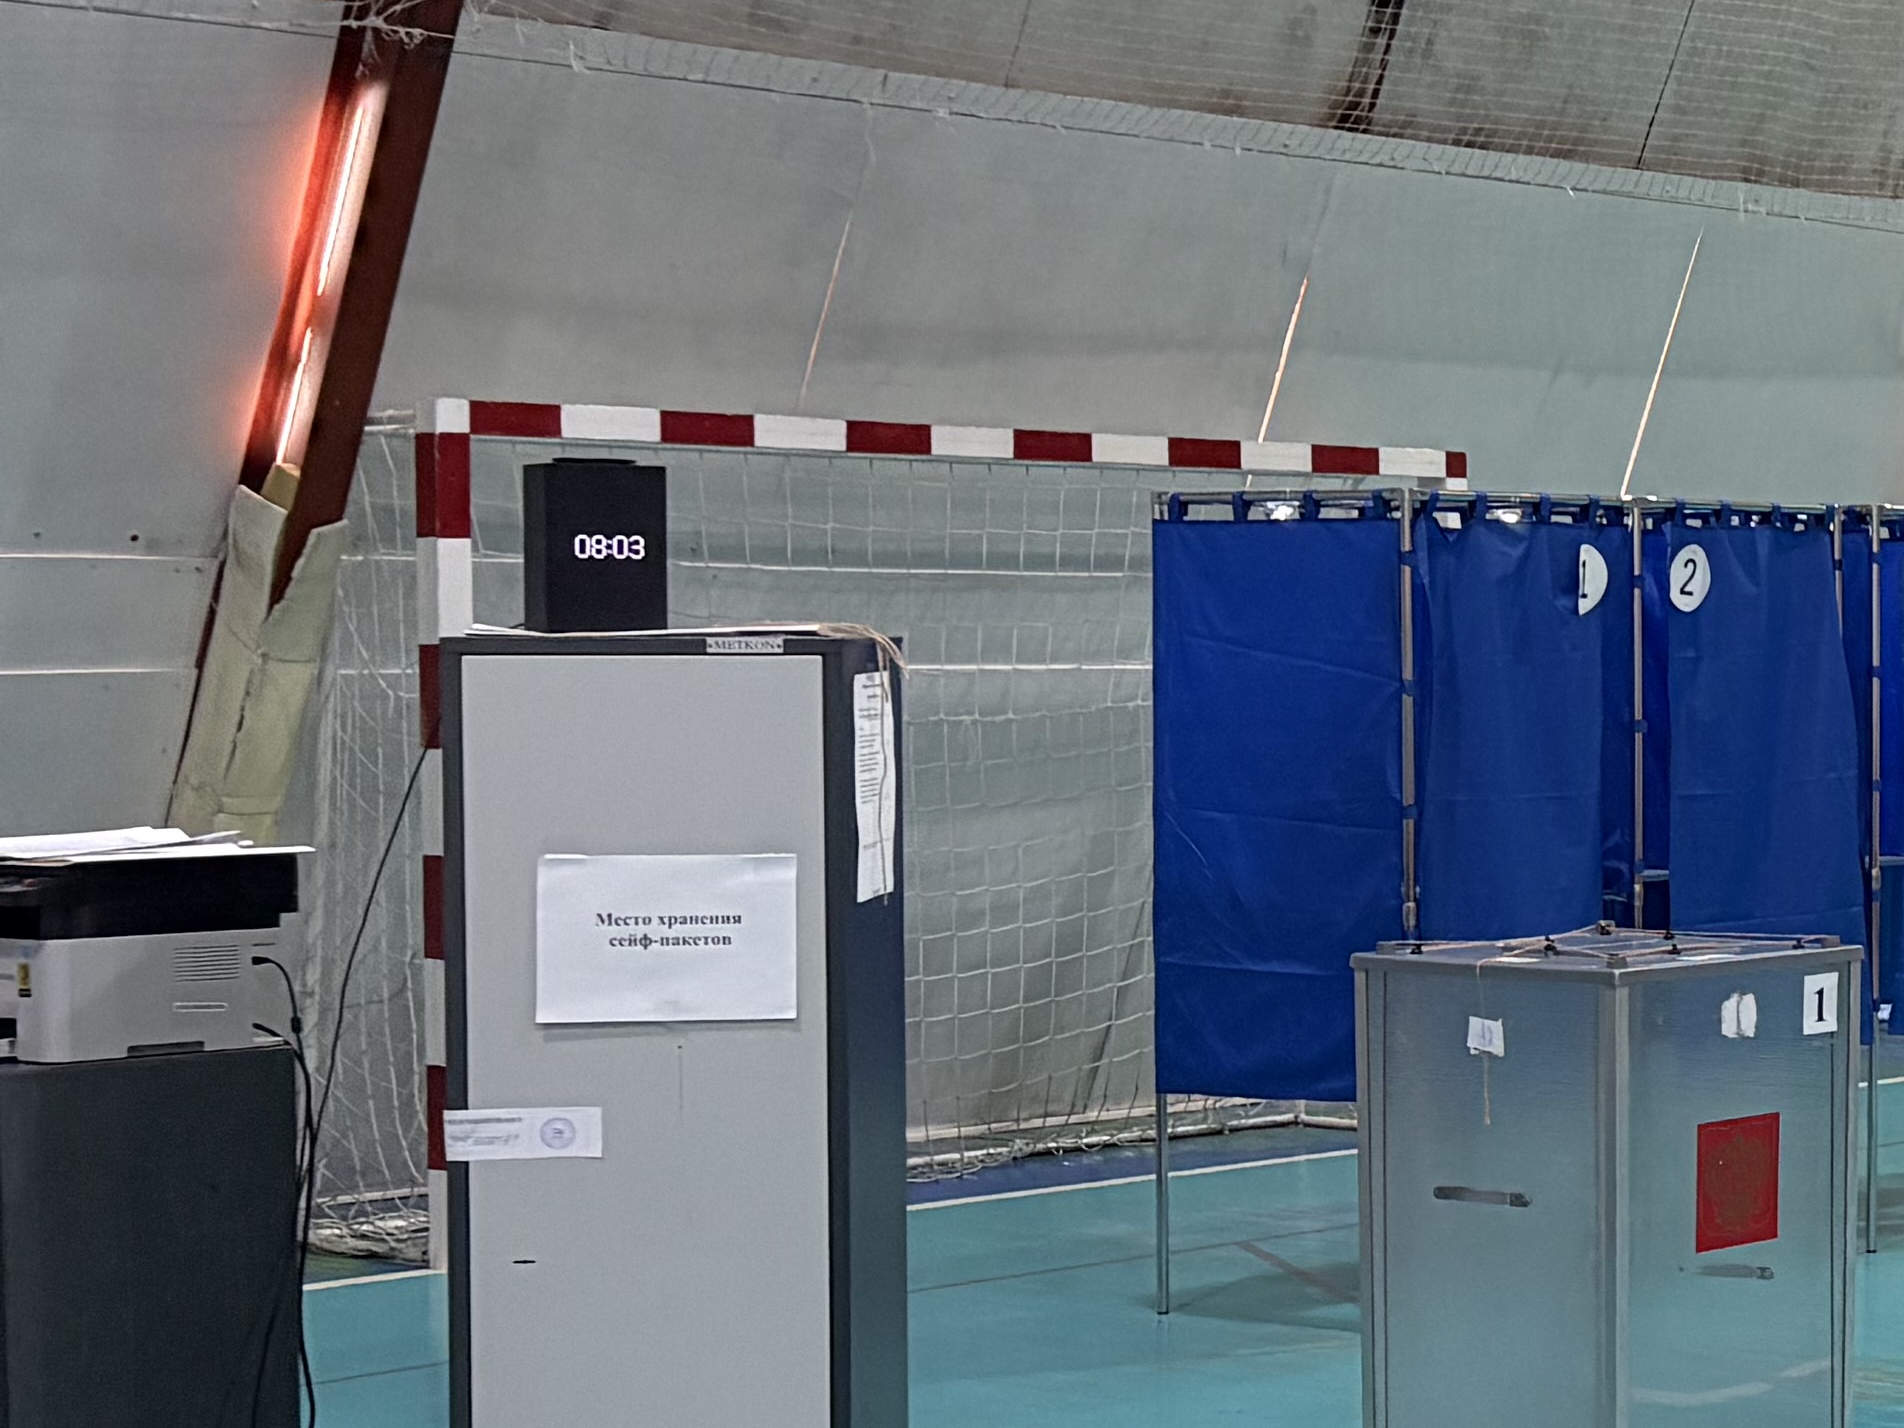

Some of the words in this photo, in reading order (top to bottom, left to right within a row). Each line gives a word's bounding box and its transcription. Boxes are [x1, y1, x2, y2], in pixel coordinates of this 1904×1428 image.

[574, 534, 646, 560] 08:03
[1679, 558, 1697, 597] 2
[595, 912, 652, 927] Место
[657, 914, 742, 929] хранения
[609, 933, 732, 950] сейф-пакетов
[1813, 986, 1828, 1023] 1
